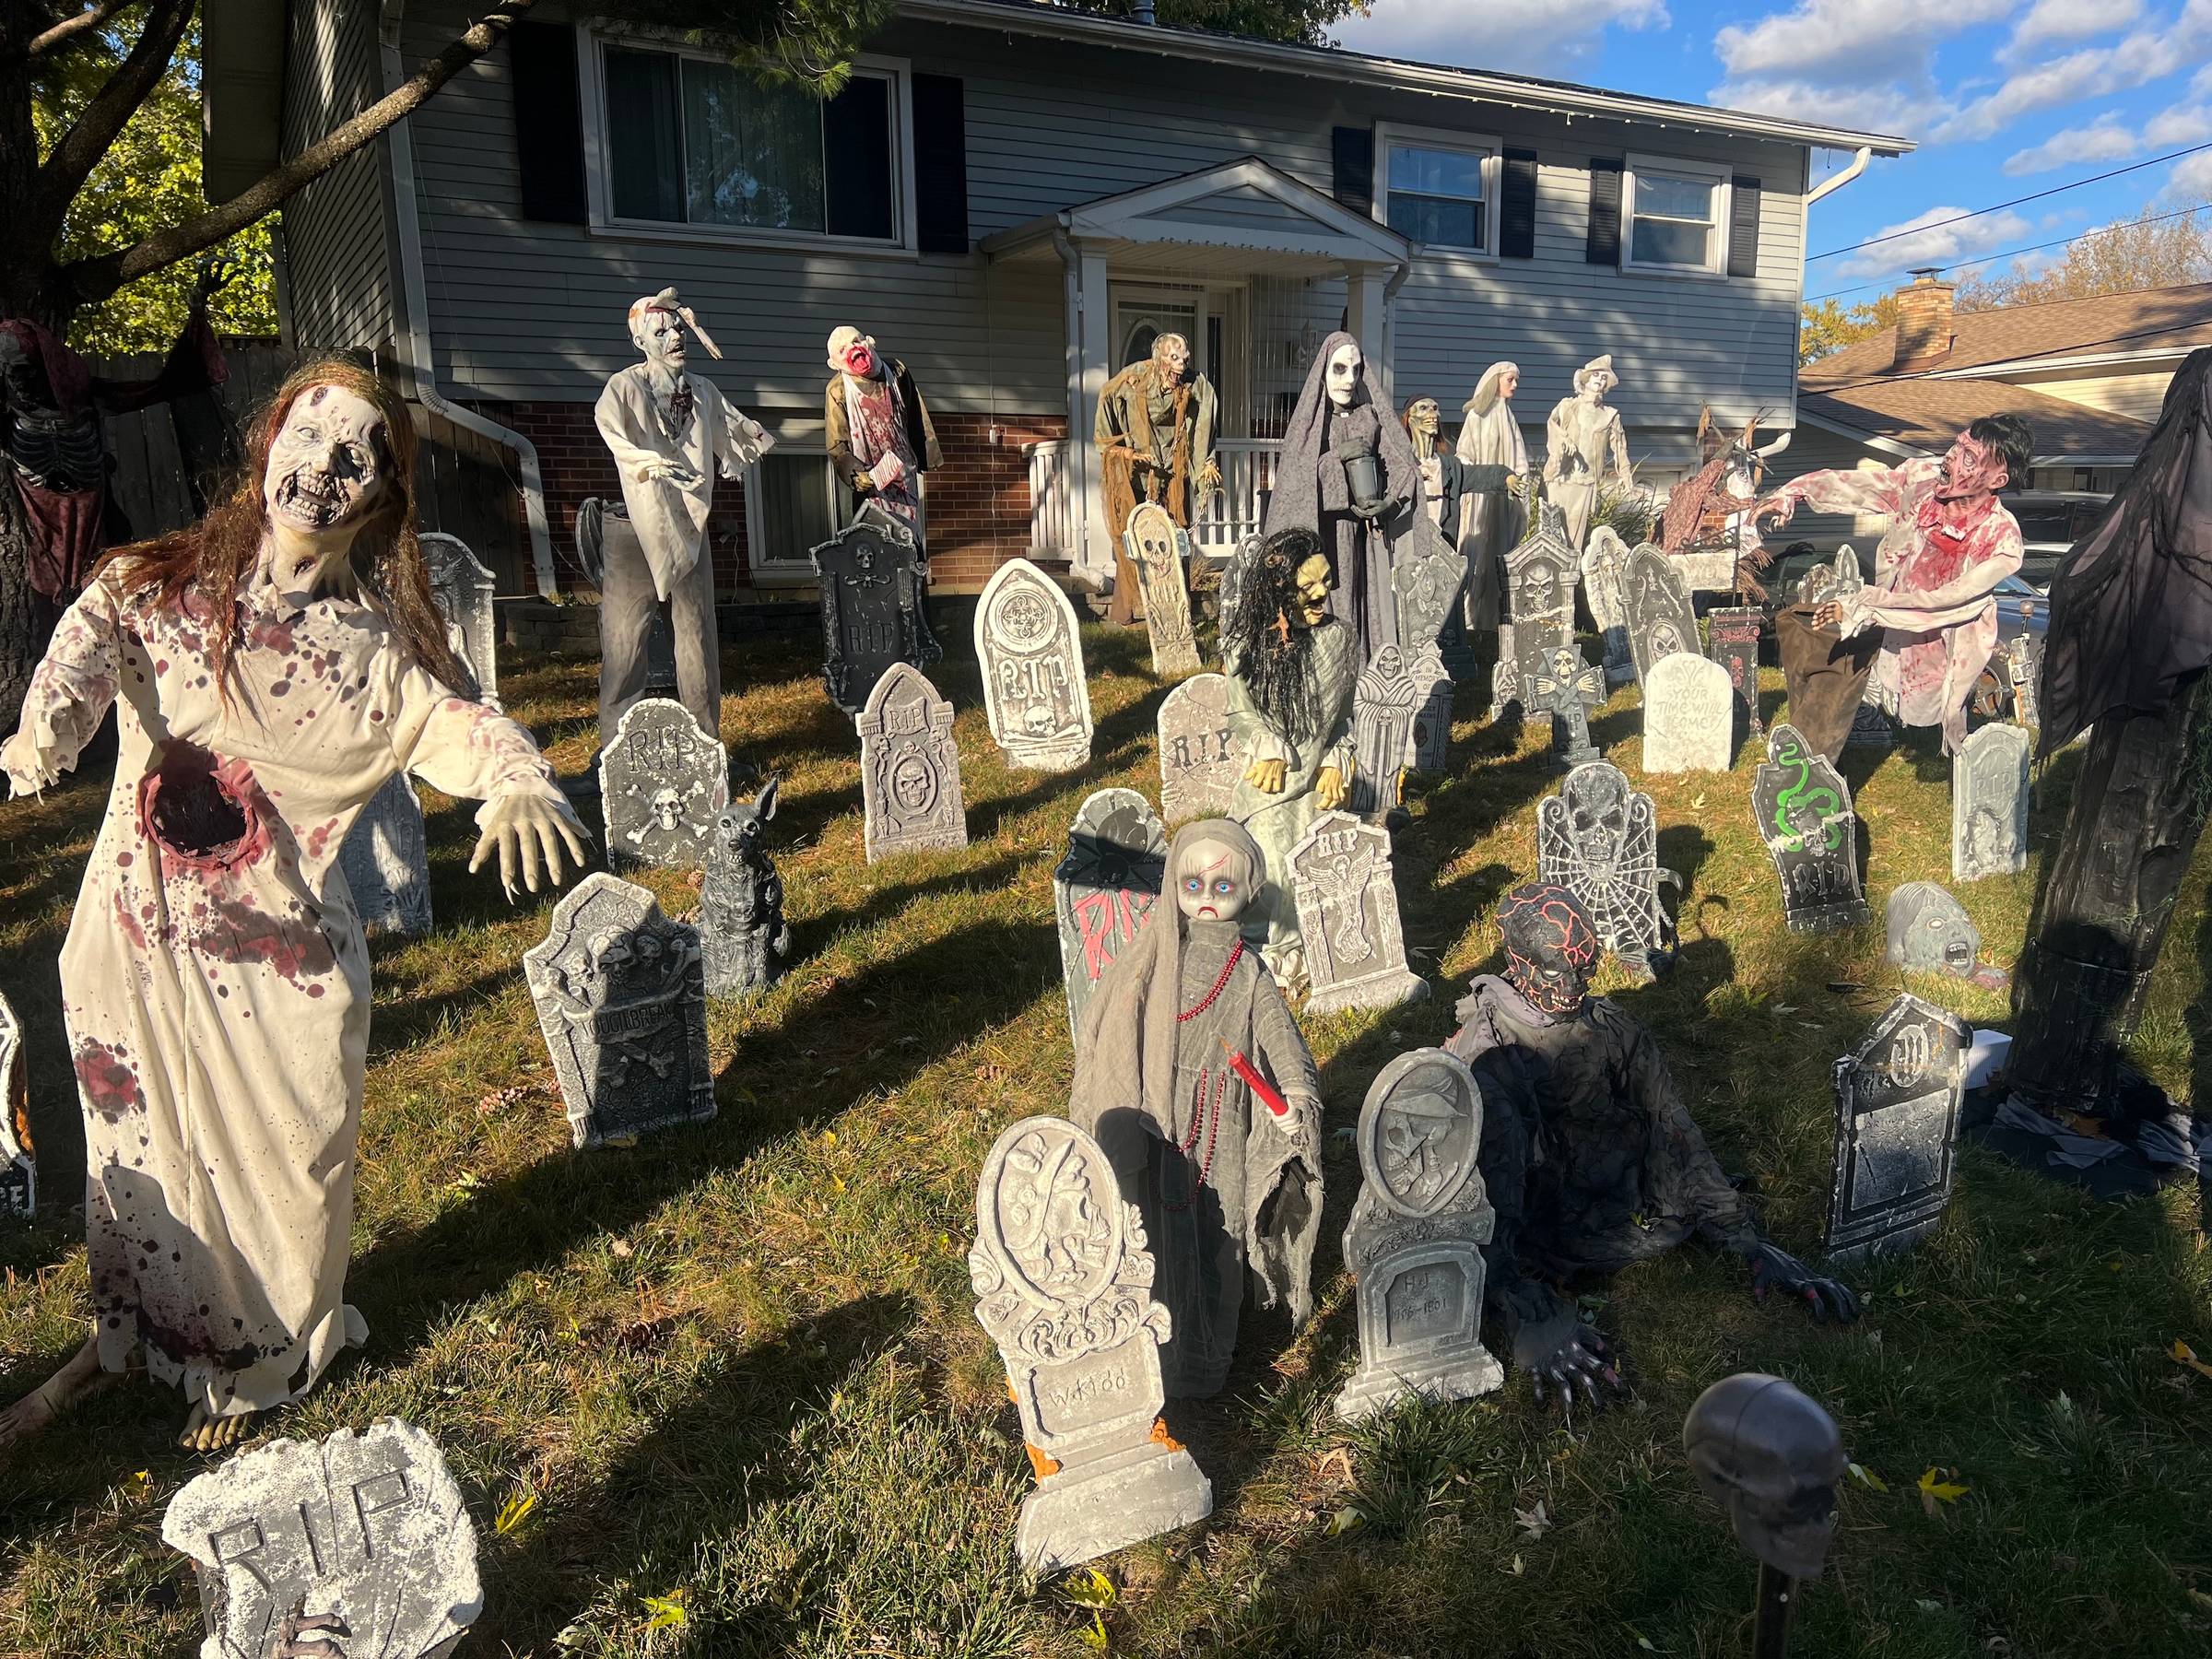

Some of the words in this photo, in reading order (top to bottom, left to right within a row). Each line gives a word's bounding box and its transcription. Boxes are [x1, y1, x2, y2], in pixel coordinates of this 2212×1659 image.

[847, 620, 894, 655] RIP
[998, 655, 1069, 701] RIP
[1672, 688, 1709, 700] YOUR
[1556, 712, 1583, 732] RIP
[629, 725, 698, 772] RIP
[1975, 771, 2012, 798] RIP
[1317, 828, 1359, 858] RIP
[208, 1469, 412, 1596] RIP
